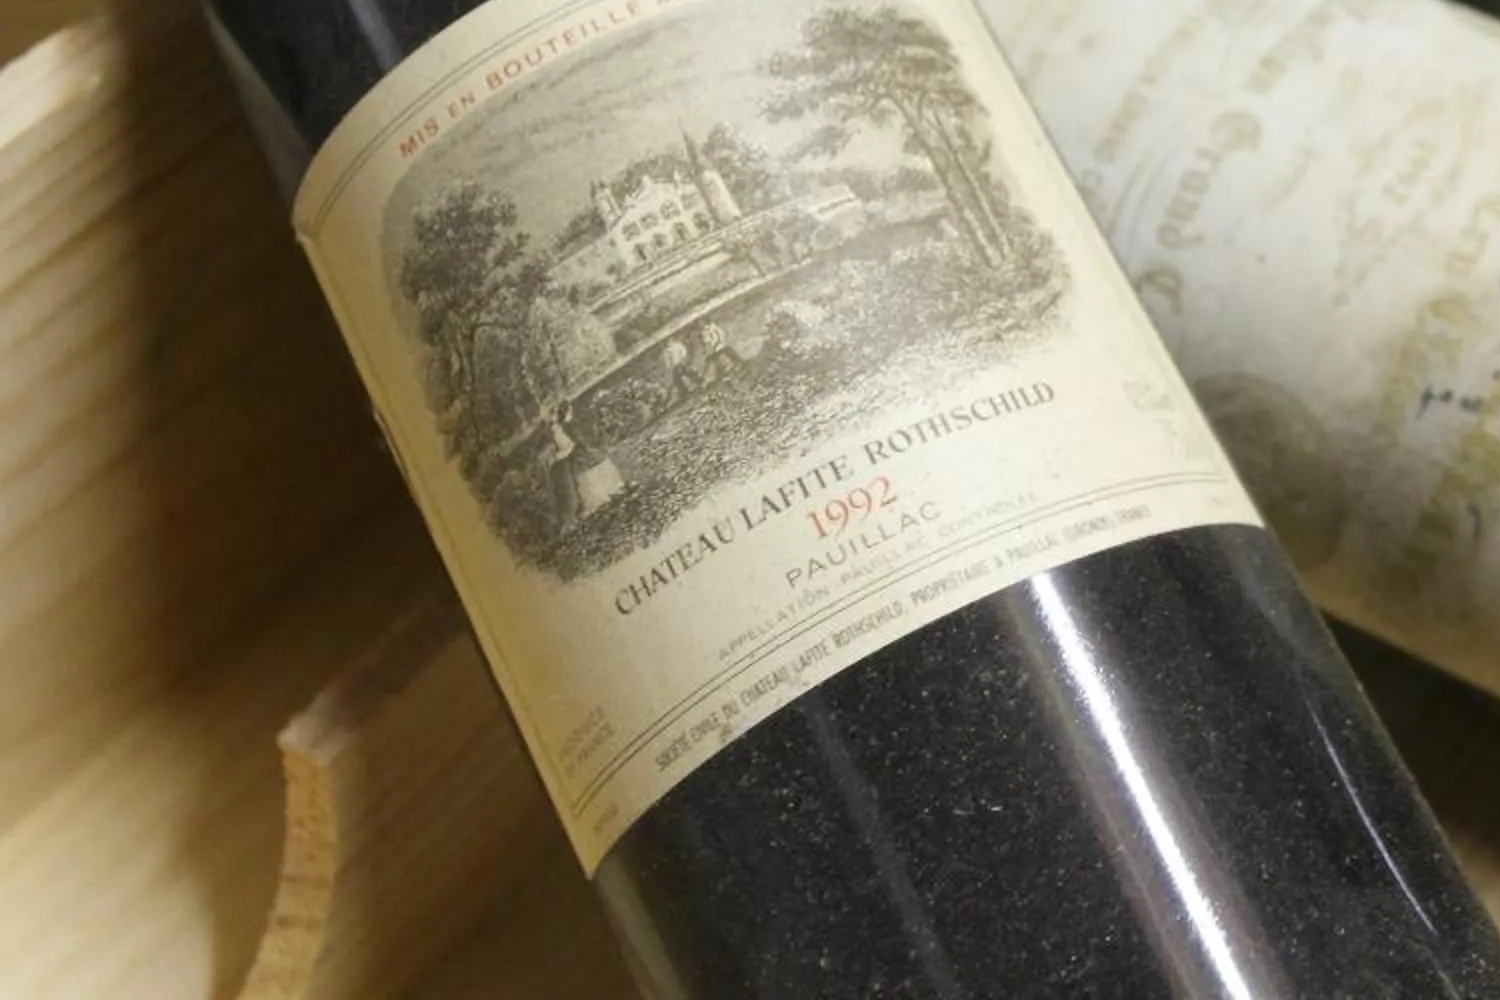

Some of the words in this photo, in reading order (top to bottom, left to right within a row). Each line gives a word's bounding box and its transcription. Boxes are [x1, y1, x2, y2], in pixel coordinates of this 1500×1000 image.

[399, 116, 440, 159] MIS
[446, 91, 476, 119] EN
[614, 515, 736, 617] CHATEAU
[739, 454, 855, 531] LAFITE
[863, 381, 1056, 467] ROTHSCHILD
[805, 475, 899, 540] 1992
[785, 500, 942, 589] PAUILLAC
[718, 588, 829, 661] APPELLATION
